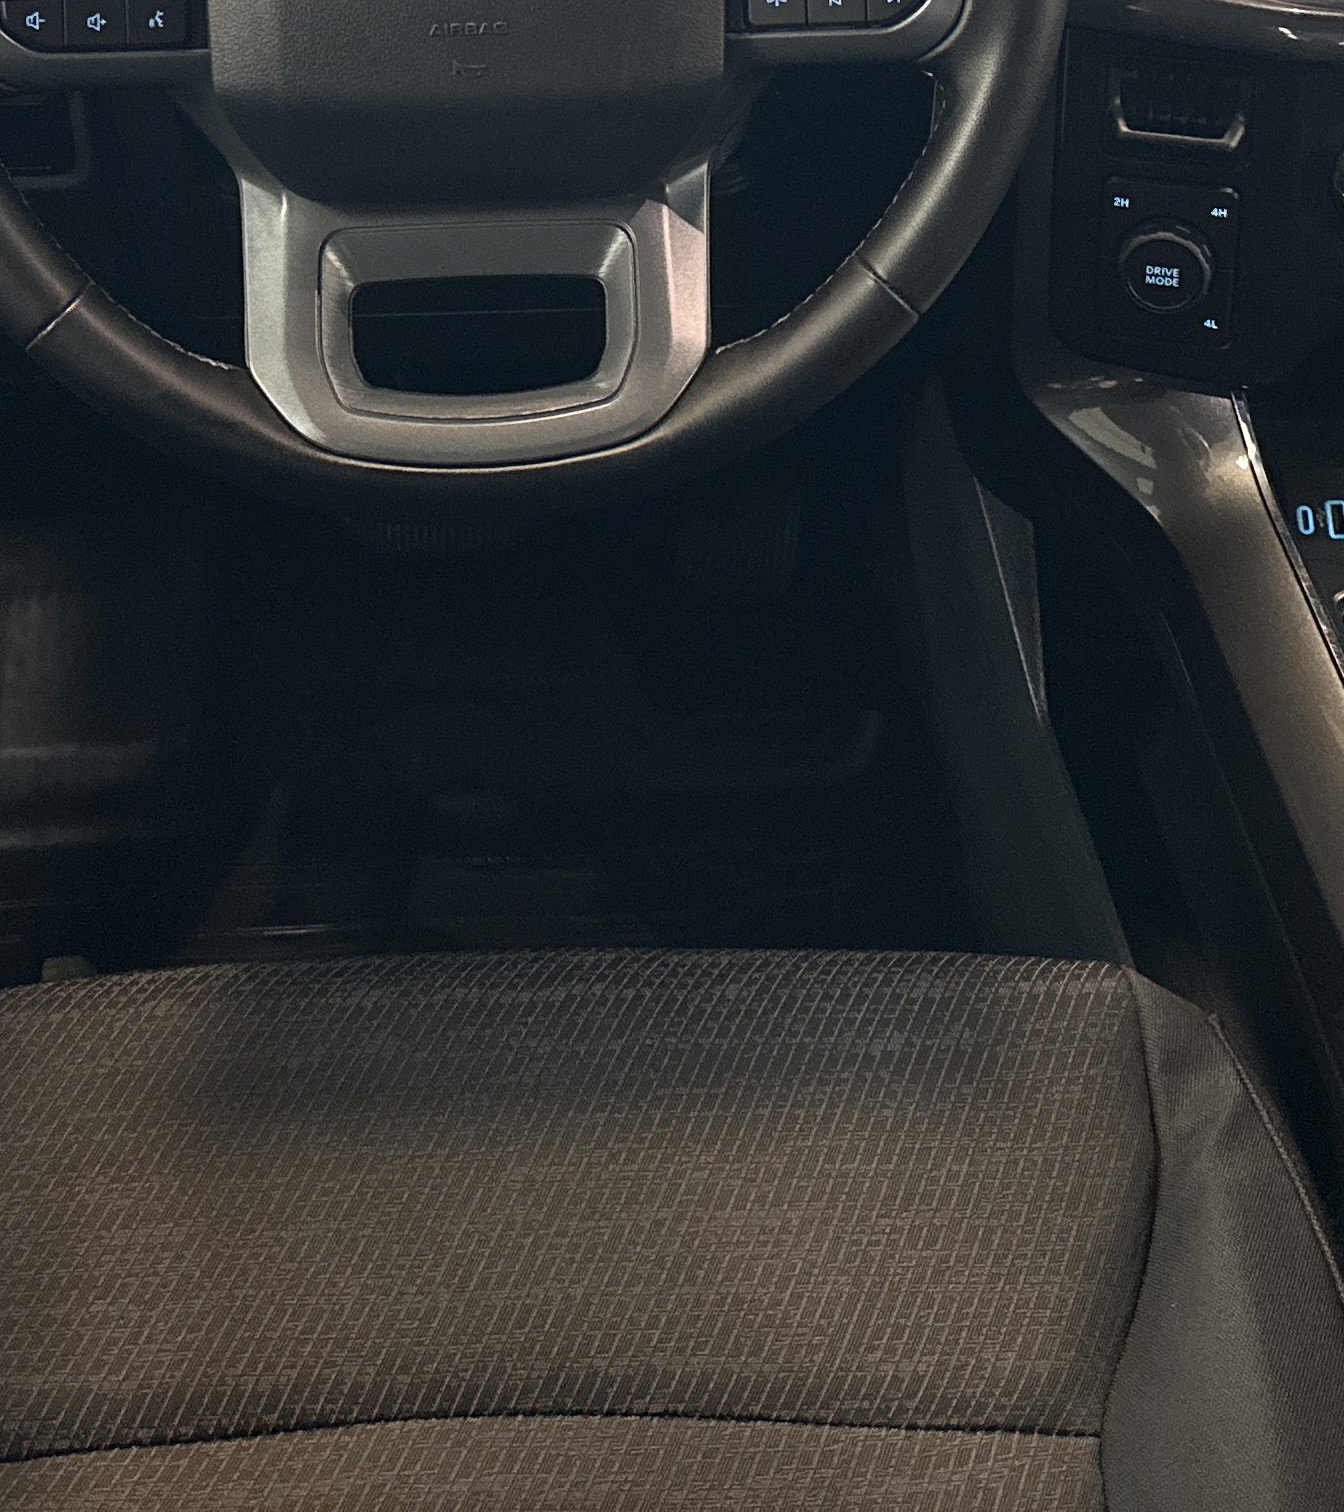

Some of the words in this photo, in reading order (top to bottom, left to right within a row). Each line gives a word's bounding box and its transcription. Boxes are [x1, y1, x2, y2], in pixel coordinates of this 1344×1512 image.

[429, 20, 509, 37] AIRBAG
[1113, 196, 1130, 209] 2H
[1210, 207, 1229, 219] 4H
[1145, 265, 1180, 278] DRIVE
[1145, 275, 1180, 288] MODE
[1203, 319, 1219, 330] 4L
